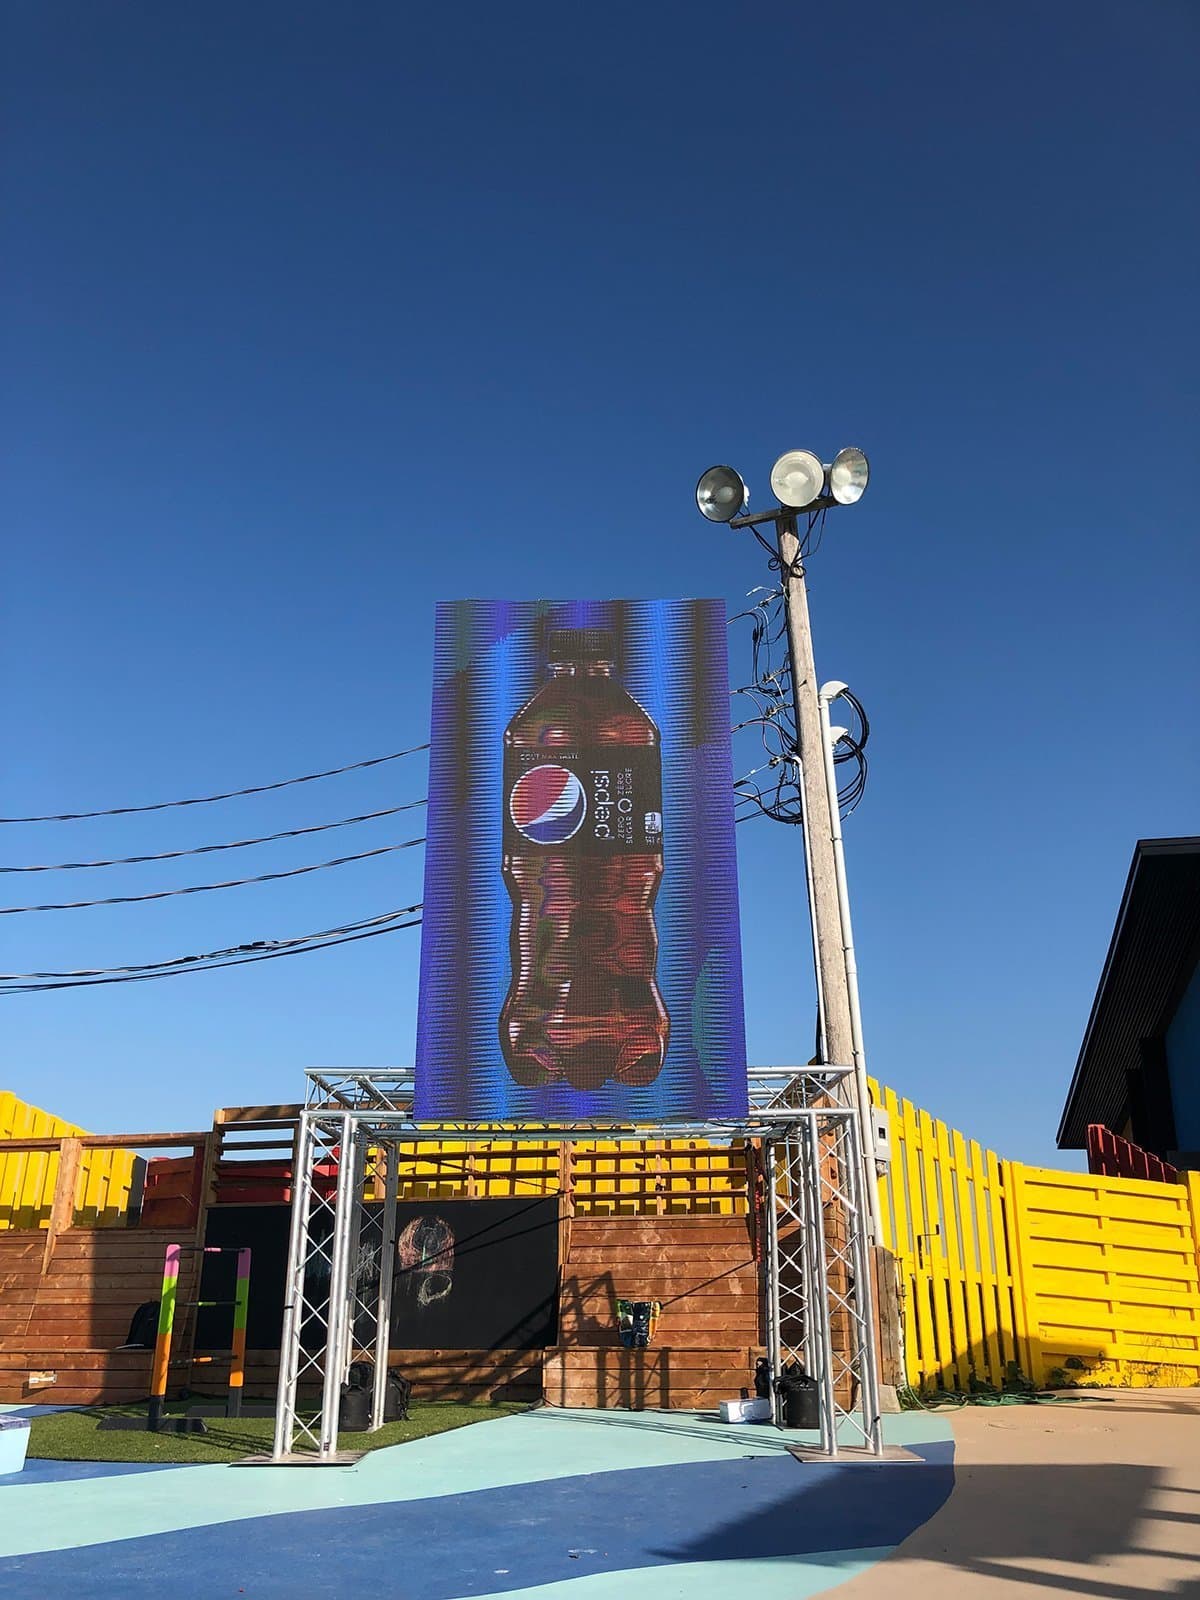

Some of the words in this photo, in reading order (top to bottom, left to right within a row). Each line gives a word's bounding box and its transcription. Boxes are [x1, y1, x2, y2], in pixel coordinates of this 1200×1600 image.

[625, 767, 633, 795] SUCRE
[590, 770, 615, 840] pepsi
[617, 816, 625, 838] ZERO
